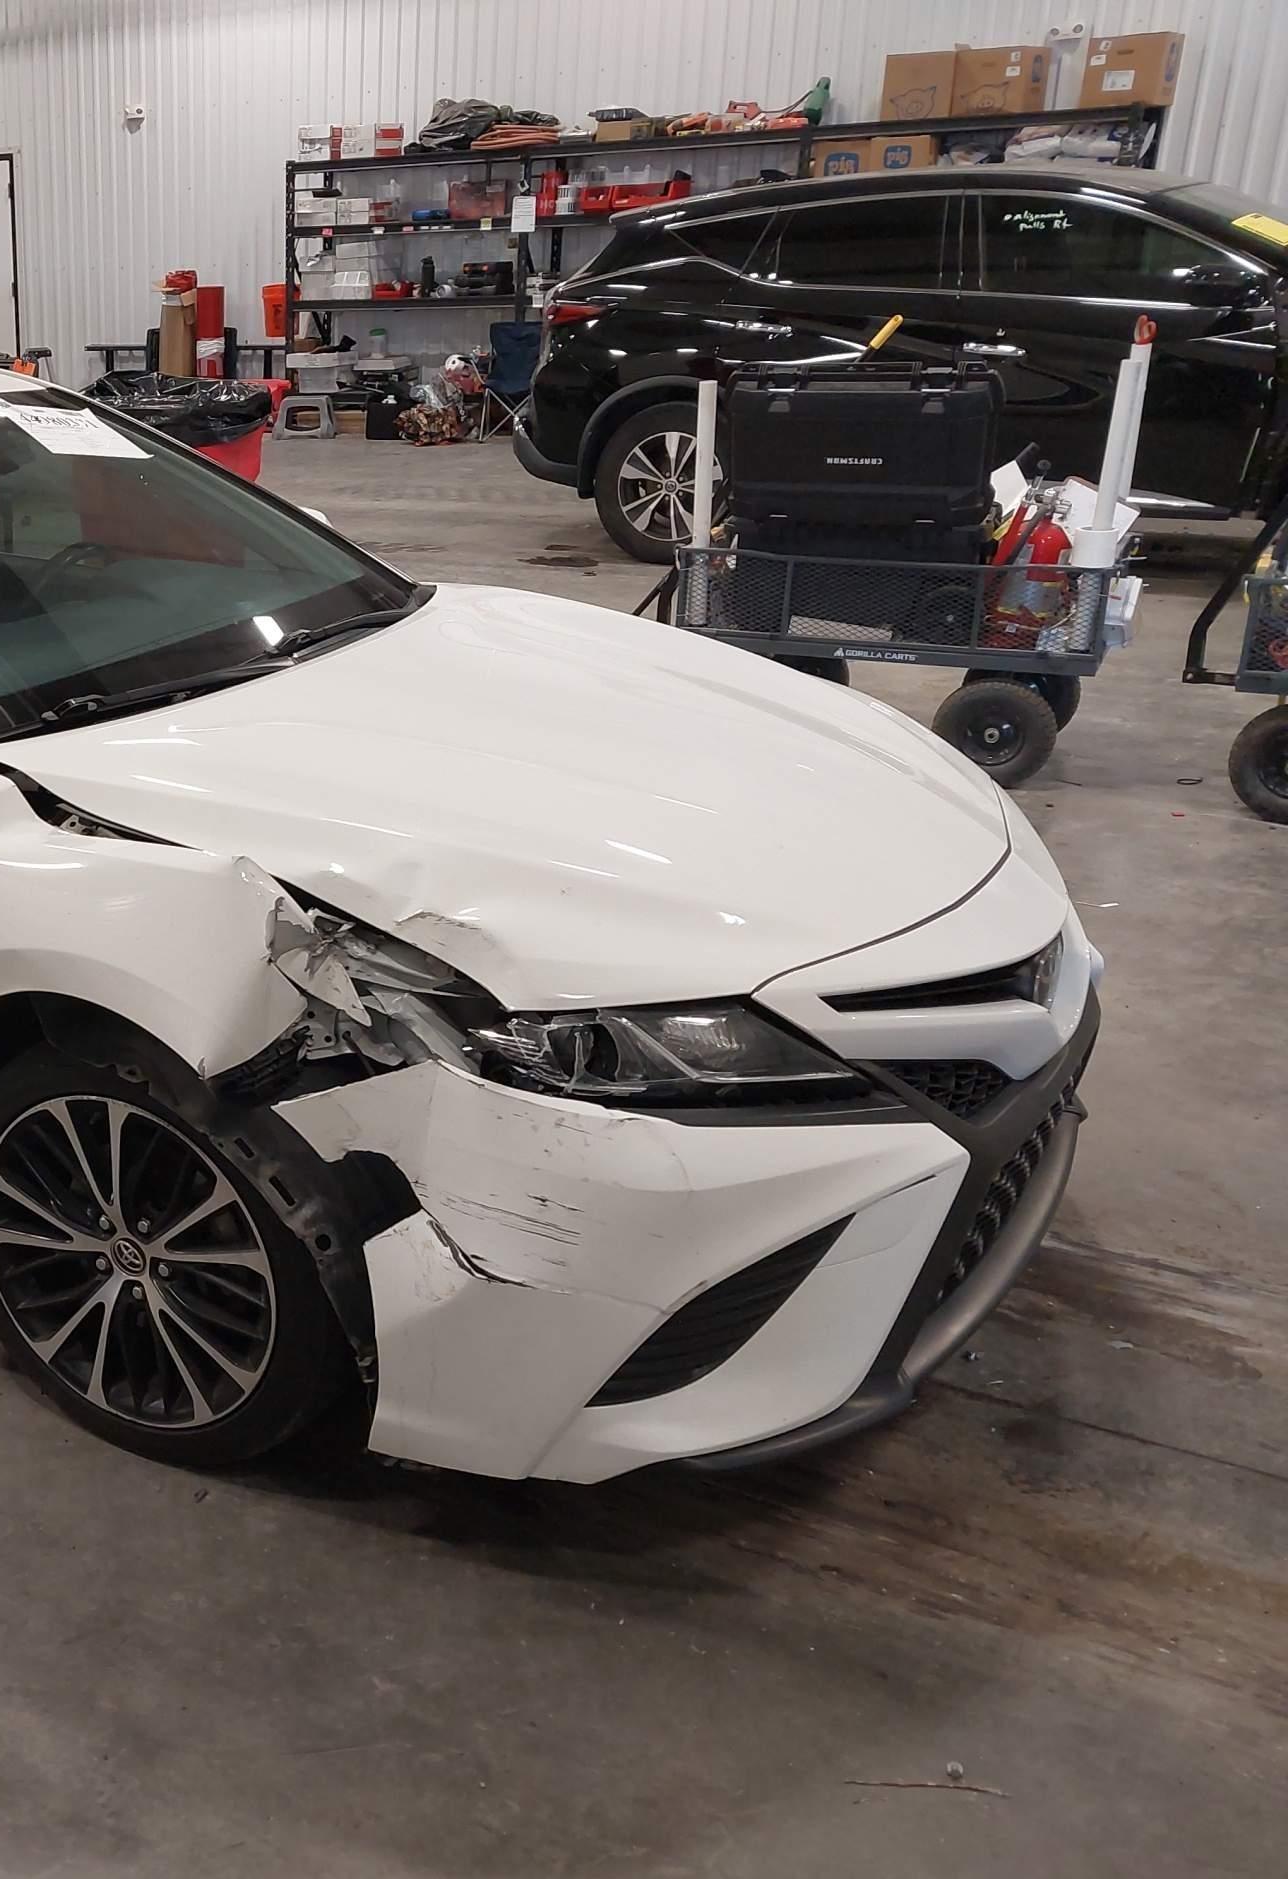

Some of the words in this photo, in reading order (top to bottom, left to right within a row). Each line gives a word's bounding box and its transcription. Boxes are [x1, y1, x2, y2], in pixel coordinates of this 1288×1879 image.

[826, 457, 883, 465] CRAFTSMAN
[845, 649, 882, 659] GORILLA
[884, 652, 916, 661] CARTS
